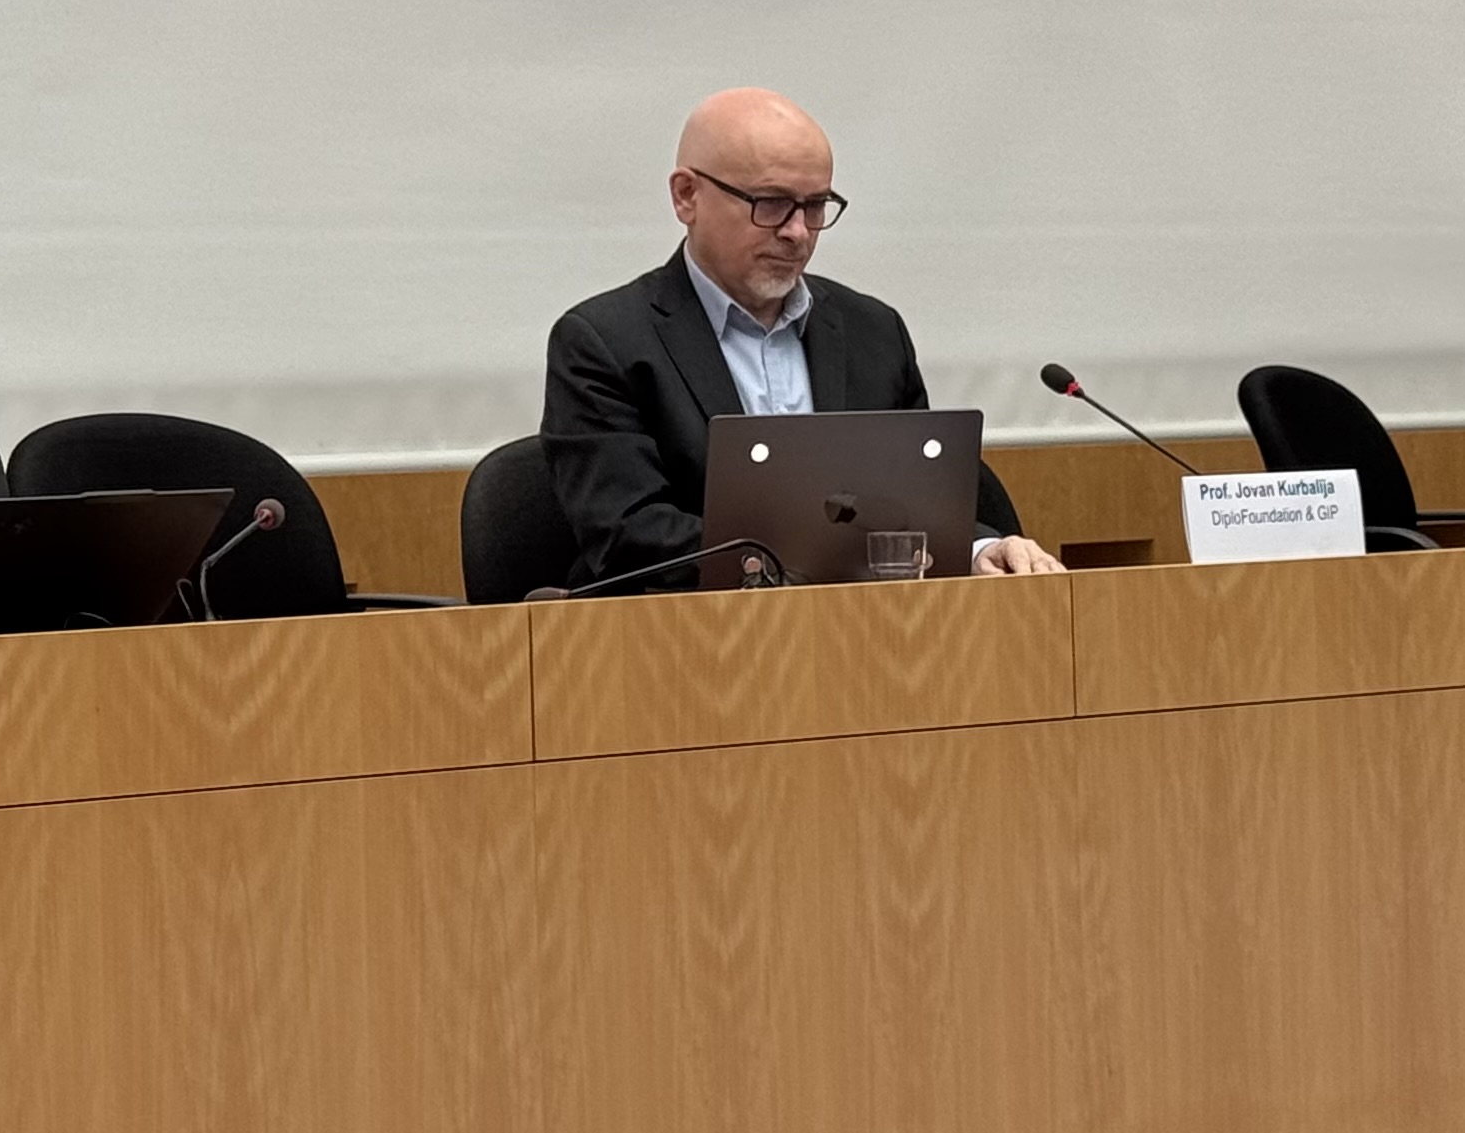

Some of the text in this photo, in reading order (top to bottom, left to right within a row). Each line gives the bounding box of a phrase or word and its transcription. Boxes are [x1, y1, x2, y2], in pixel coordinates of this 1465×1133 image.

[1199, 479, 1336, 501] Prof. Jovan Kurbalija
[1211, 504, 1339, 529] DiploFoundation & GIP
